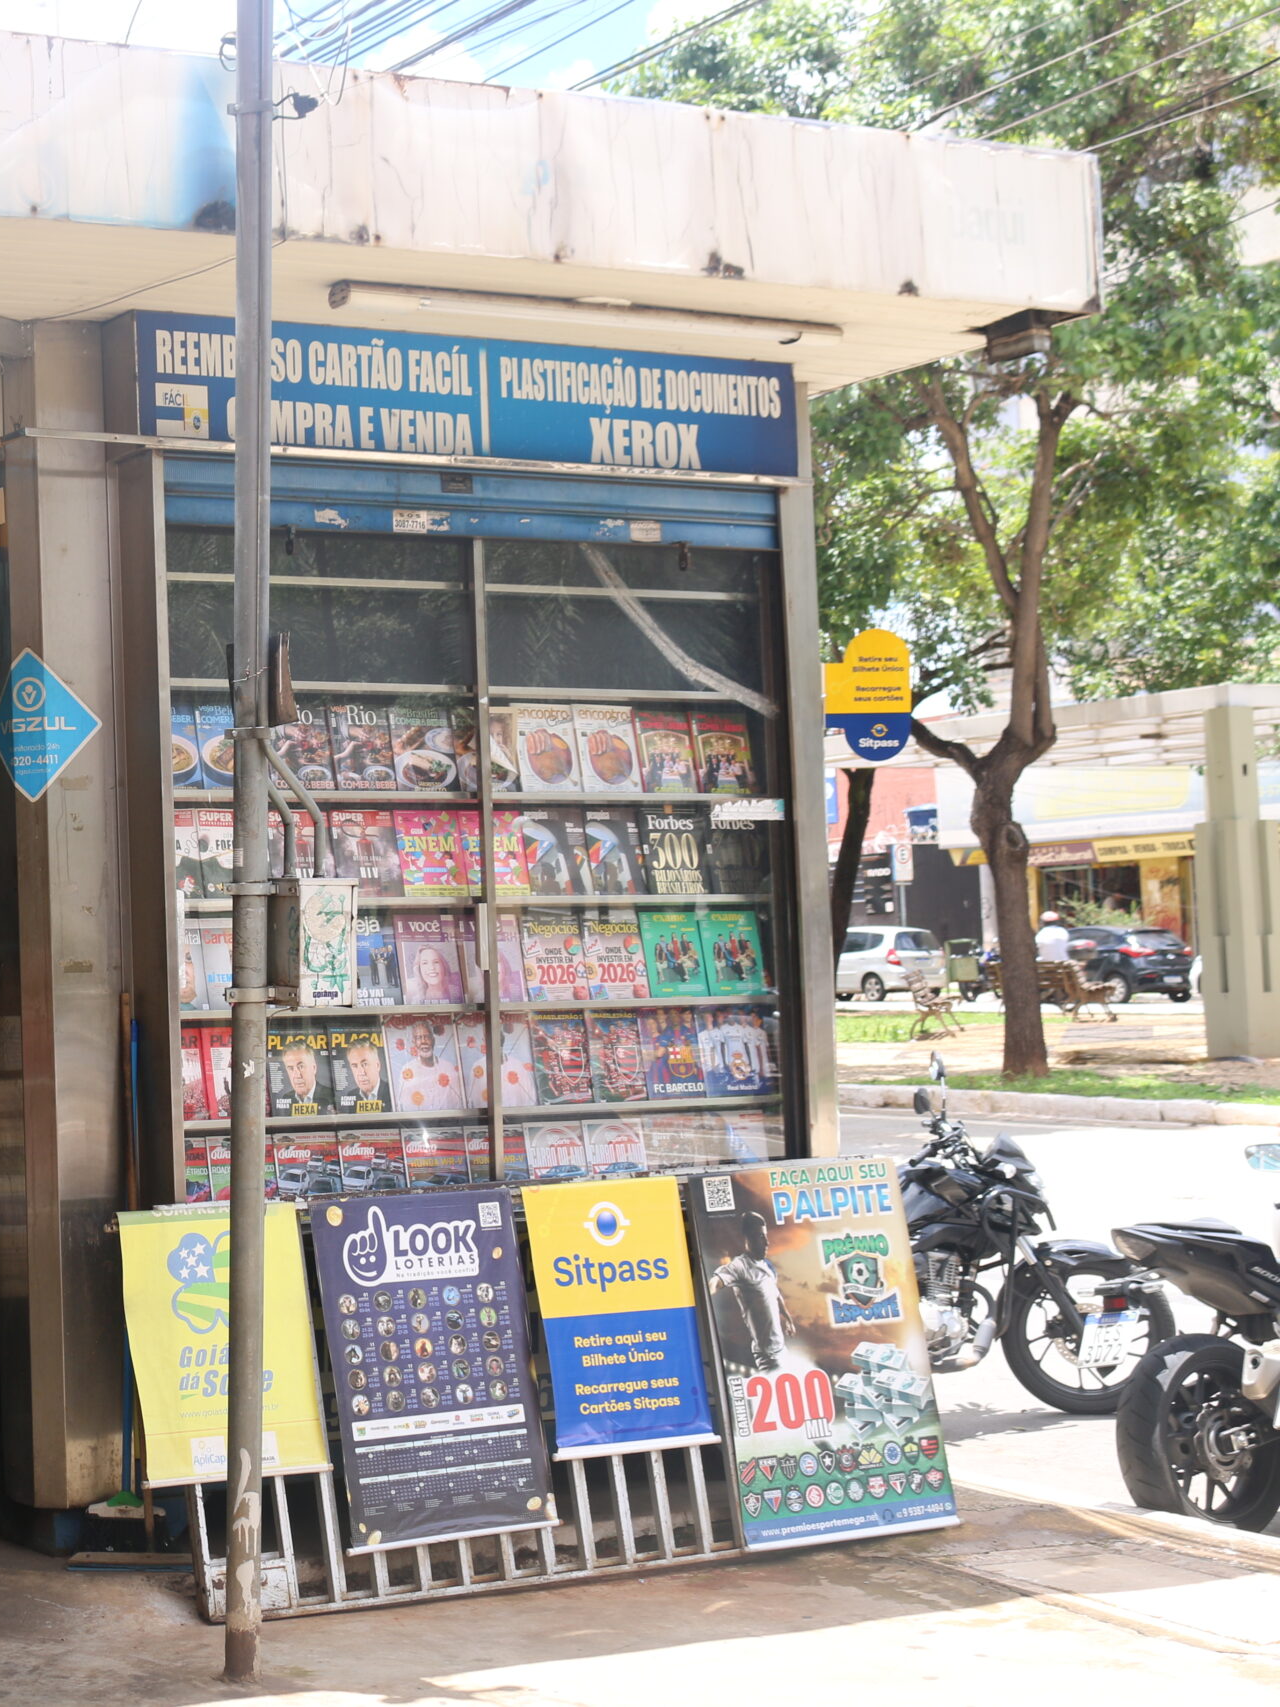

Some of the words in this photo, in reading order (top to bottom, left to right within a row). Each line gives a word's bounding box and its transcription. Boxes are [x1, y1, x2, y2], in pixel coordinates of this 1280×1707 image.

[155, 329, 303, 384] REEMBSO
[309, 337, 403, 392] CARTÃO
[408, 345, 473, 397] FACÍL
[499, 356, 637, 414] PLASTIFICAÇÃO
[640, 367, 662, 411] DE
[665, 369, 782, 419] DOCUMENTOS
[226, 396, 354, 448] CMPRA
[358, 406, 375, 450] E
[380, 407, 475, 457] VENDA
[589, 416, 702, 470] XEROX
[347, 704, 377, 726] Rio
[0, 716, 77, 736] VIGZUL
[858, 737, 900, 750] Sitpass
[11, 753, 59, 767] 020-4411
[332, 811, 364, 822] SUPER
[646, 815, 694, 830] Forbes
[404, 835, 457, 852] ENEM
[648, 832, 700, 870] 300
[355, 915, 380, 937] eja
[529, 921, 579, 937] Negócios
[589, 920, 638, 936] Negócios
[535, 955, 563, 965] INVESTIR
[564, 955, 574, 963] EM
[545, 947, 563, 956] ONDE
[596, 955, 624, 964] INVESTIR
[624, 954, 633, 963] EM
[605, 946, 623, 955] ONDE
[536, 964, 577, 985] 2026
[598, 963, 636, 984] 2026
[653, 1083, 665, 1094] FC
[665, 1081, 704, 1094] BARCELO
[293, 1104, 316, 1116] HEXA
[358, 1101, 380, 1113] HEXA
[278, 1146, 311, 1160] QUATRO
[342, 1144, 376, 1158] QUATRO
[770, 1168, 811, 1187] FAÇA
[816, 1166, 854, 1184] AQUI
[858, 1163, 887, 1180] SEU
[771, 1182, 894, 1223] PALPITE
[392, 1224, 476, 1258] LOOK
[821, 1232, 890, 1266] PRÊMIO
[395, 1254, 476, 1271] LOTERIAS
[407, 1270, 435, 1279] tradição
[436, 1268, 453, 1276] você
[553, 1253, 670, 1293] Sitpass
[830, 1291, 901, 1325] ESPORTE
[574, 1335, 614, 1349] Retire
[614, 1330, 644, 1346] aqui
[645, 1331, 668, 1343] seu
[178, 1341, 230, 1369] Goiá
[581, 1353, 627, 1368] Bilhete
[628, 1348, 665, 1363] Único
[178, 1371, 201, 1391] dá
[201, 1369, 275, 1398] Soe
[574, 1378, 649, 1396] Recarregue
[650, 1376, 680, 1389] seus
[579, 1399, 632, 1416] Cartões
[633, 1395, 681, 1411] Sitpass
[746, 1369, 835, 1434] 200
[805, 1416, 832, 1440] MIL
[192, 1447, 227, 1467] ApliCap
[760, 1511, 879, 1538] www.premioesportemega.net
